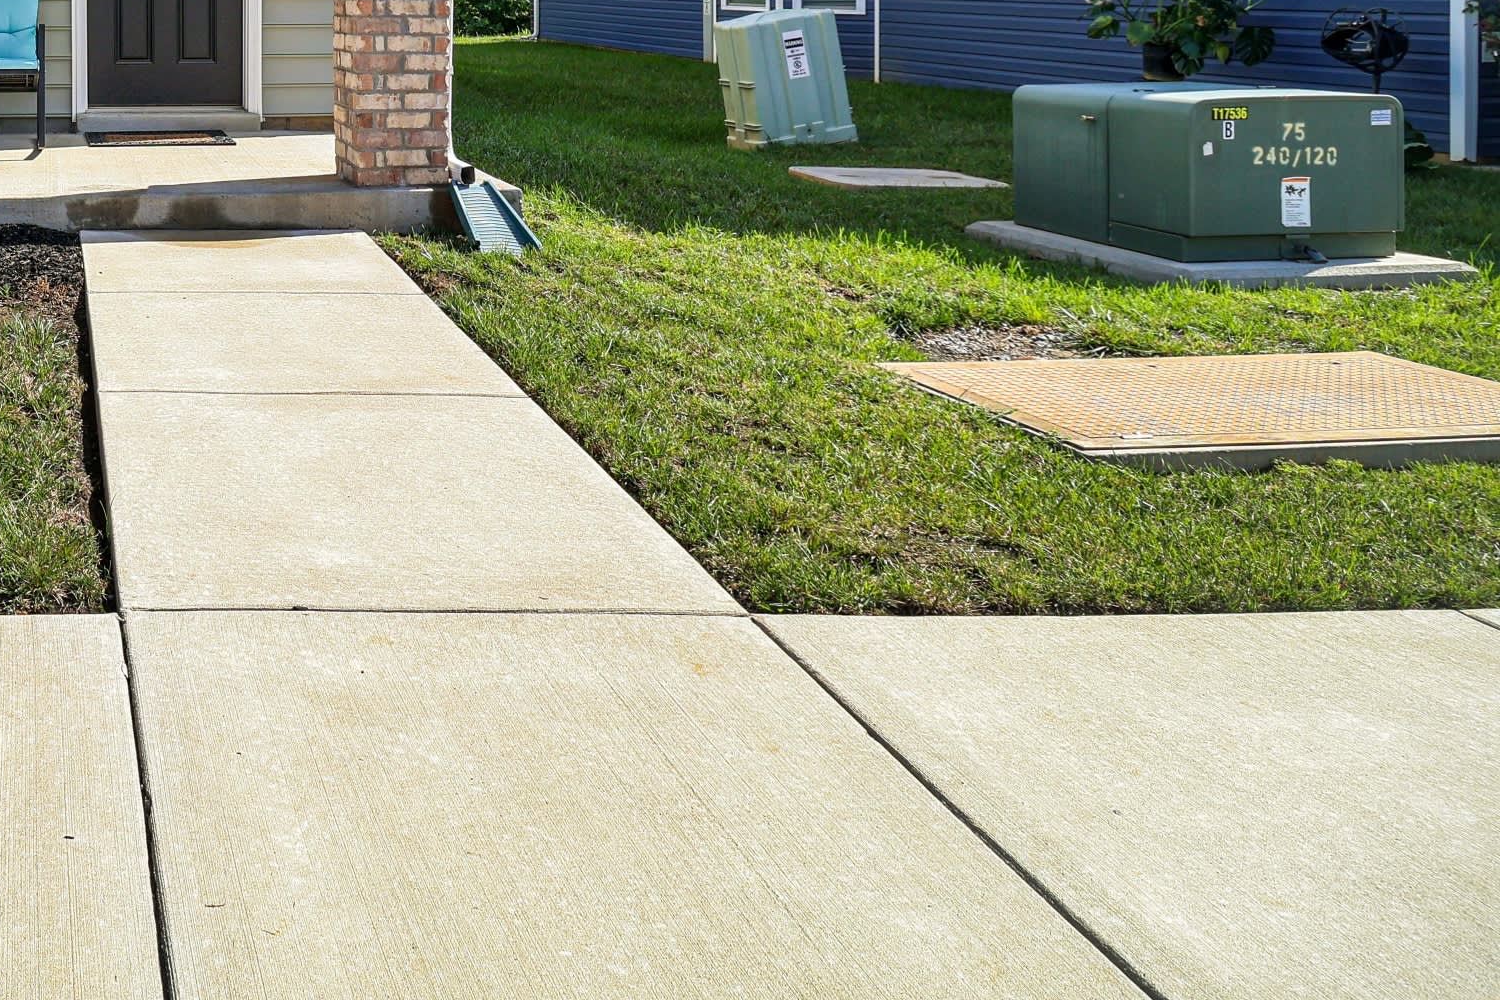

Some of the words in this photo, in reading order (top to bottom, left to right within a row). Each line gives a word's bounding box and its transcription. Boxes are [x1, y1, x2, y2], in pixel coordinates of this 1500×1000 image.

[1212, 107, 1248, 120] T17536
[1225, 121, 1233, 138] B
[1281, 122, 1305, 141] 75
[1252, 146, 1337, 168] 240/120
